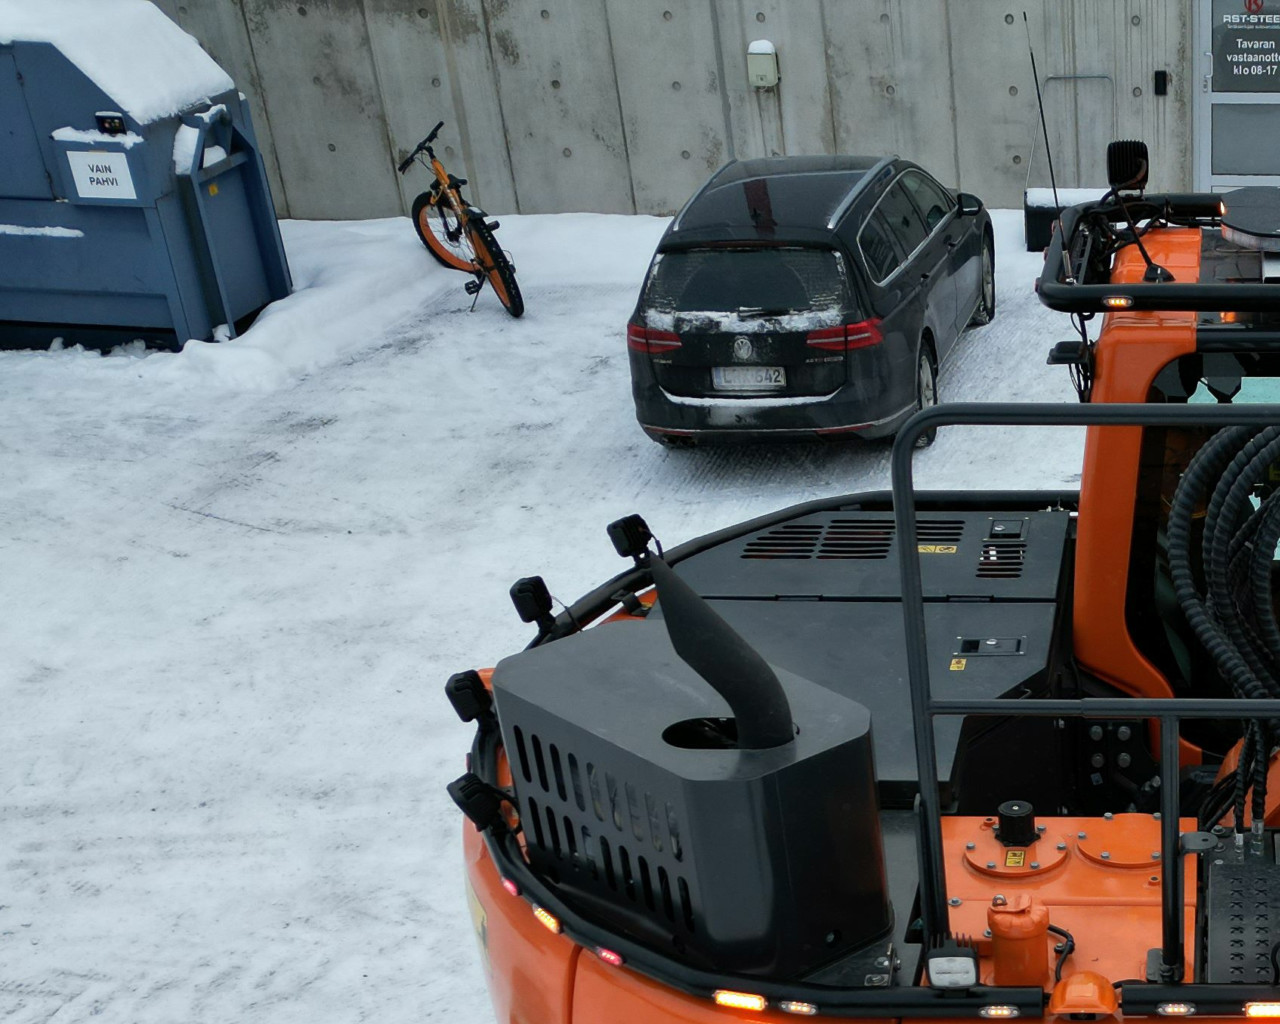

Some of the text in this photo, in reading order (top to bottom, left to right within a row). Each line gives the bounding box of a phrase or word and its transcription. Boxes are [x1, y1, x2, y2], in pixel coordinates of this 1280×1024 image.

[1236, 38, 1276, 49] Tavaran
[1233, 65, 1278, 75] klo 08-17
[88, 164, 112, 174] VAIN
[89, 177, 119, 186] PAHVI
